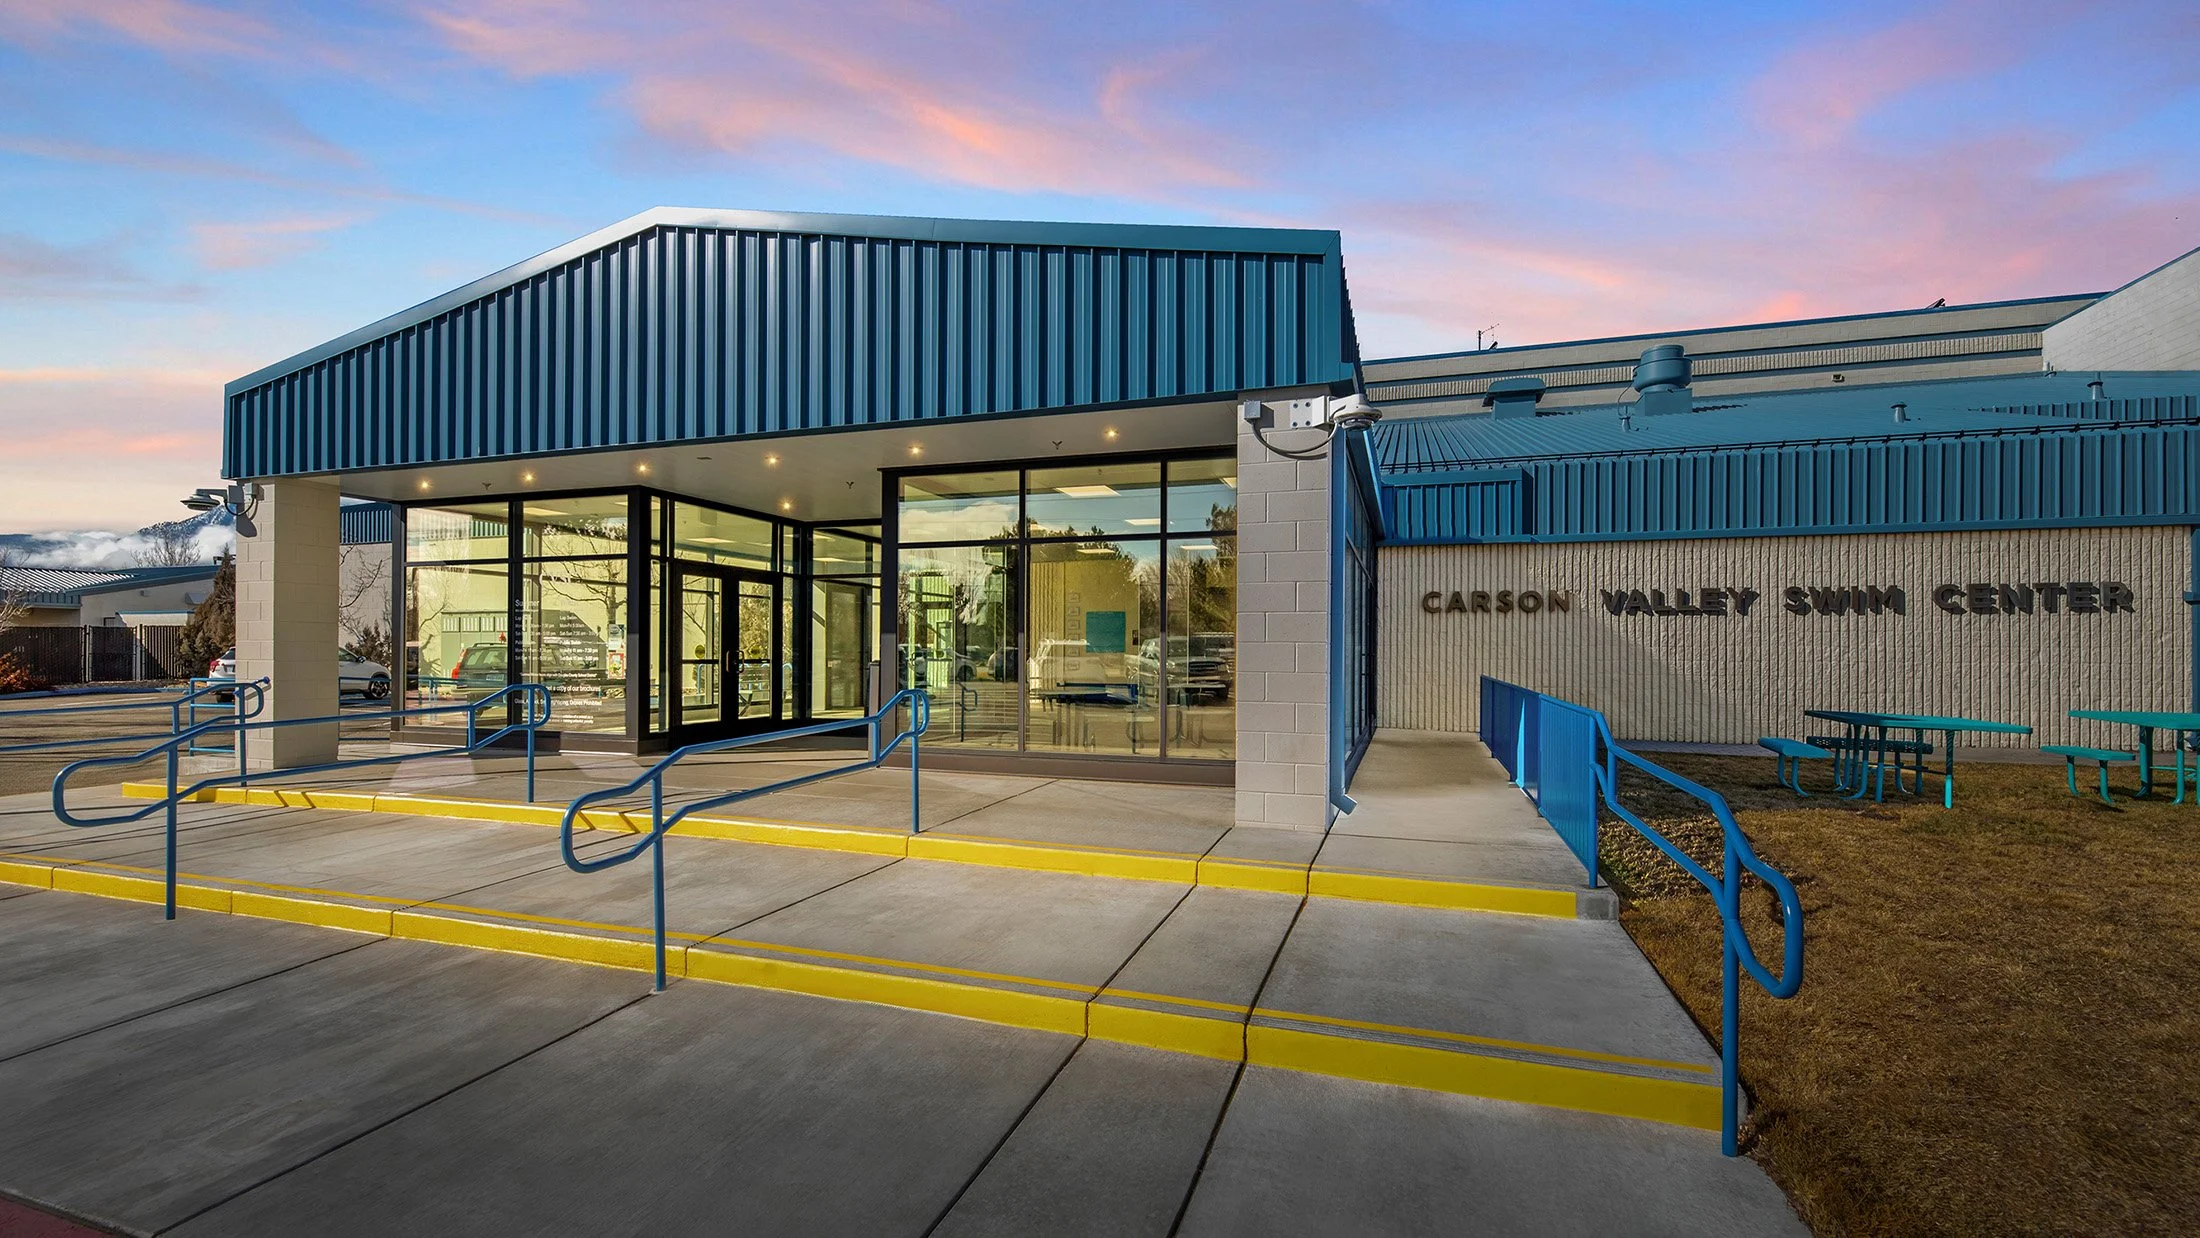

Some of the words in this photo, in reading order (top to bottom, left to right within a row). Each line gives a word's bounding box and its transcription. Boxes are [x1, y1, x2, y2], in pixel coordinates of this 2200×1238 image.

[1422, 589, 1570, 614] CARSON
[1600, 588, 1759, 616] VALLEY
[1784, 585, 1905, 616] SWIM
[1933, 581, 2135, 615] CENTER
